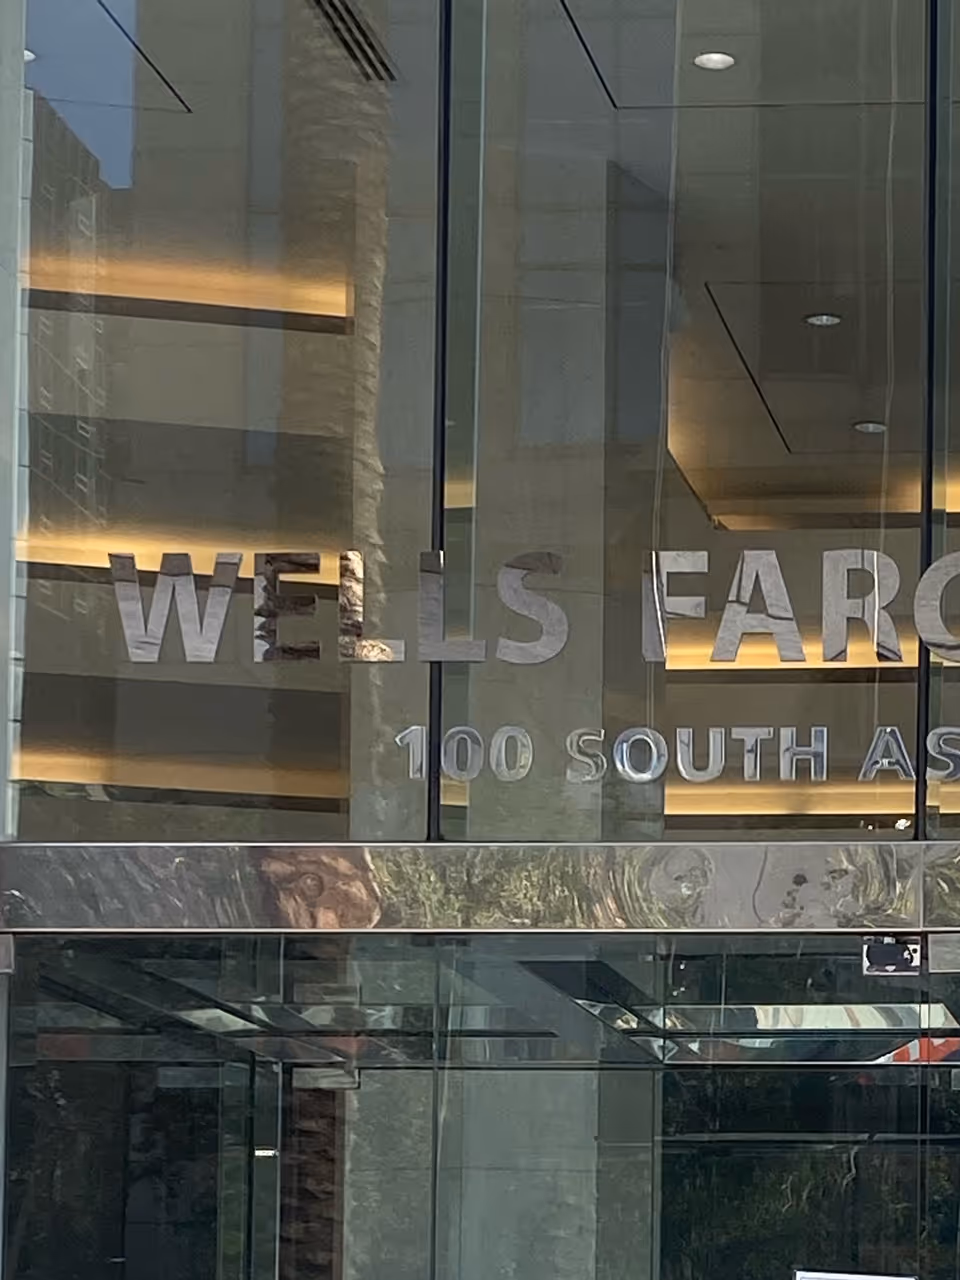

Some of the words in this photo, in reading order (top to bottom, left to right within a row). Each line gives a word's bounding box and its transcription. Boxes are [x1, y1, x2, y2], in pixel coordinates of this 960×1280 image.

[107, 549, 571, 665] WELLS
[394, 724, 534, 783] 100
[564, 726, 830, 784] SOUTH
